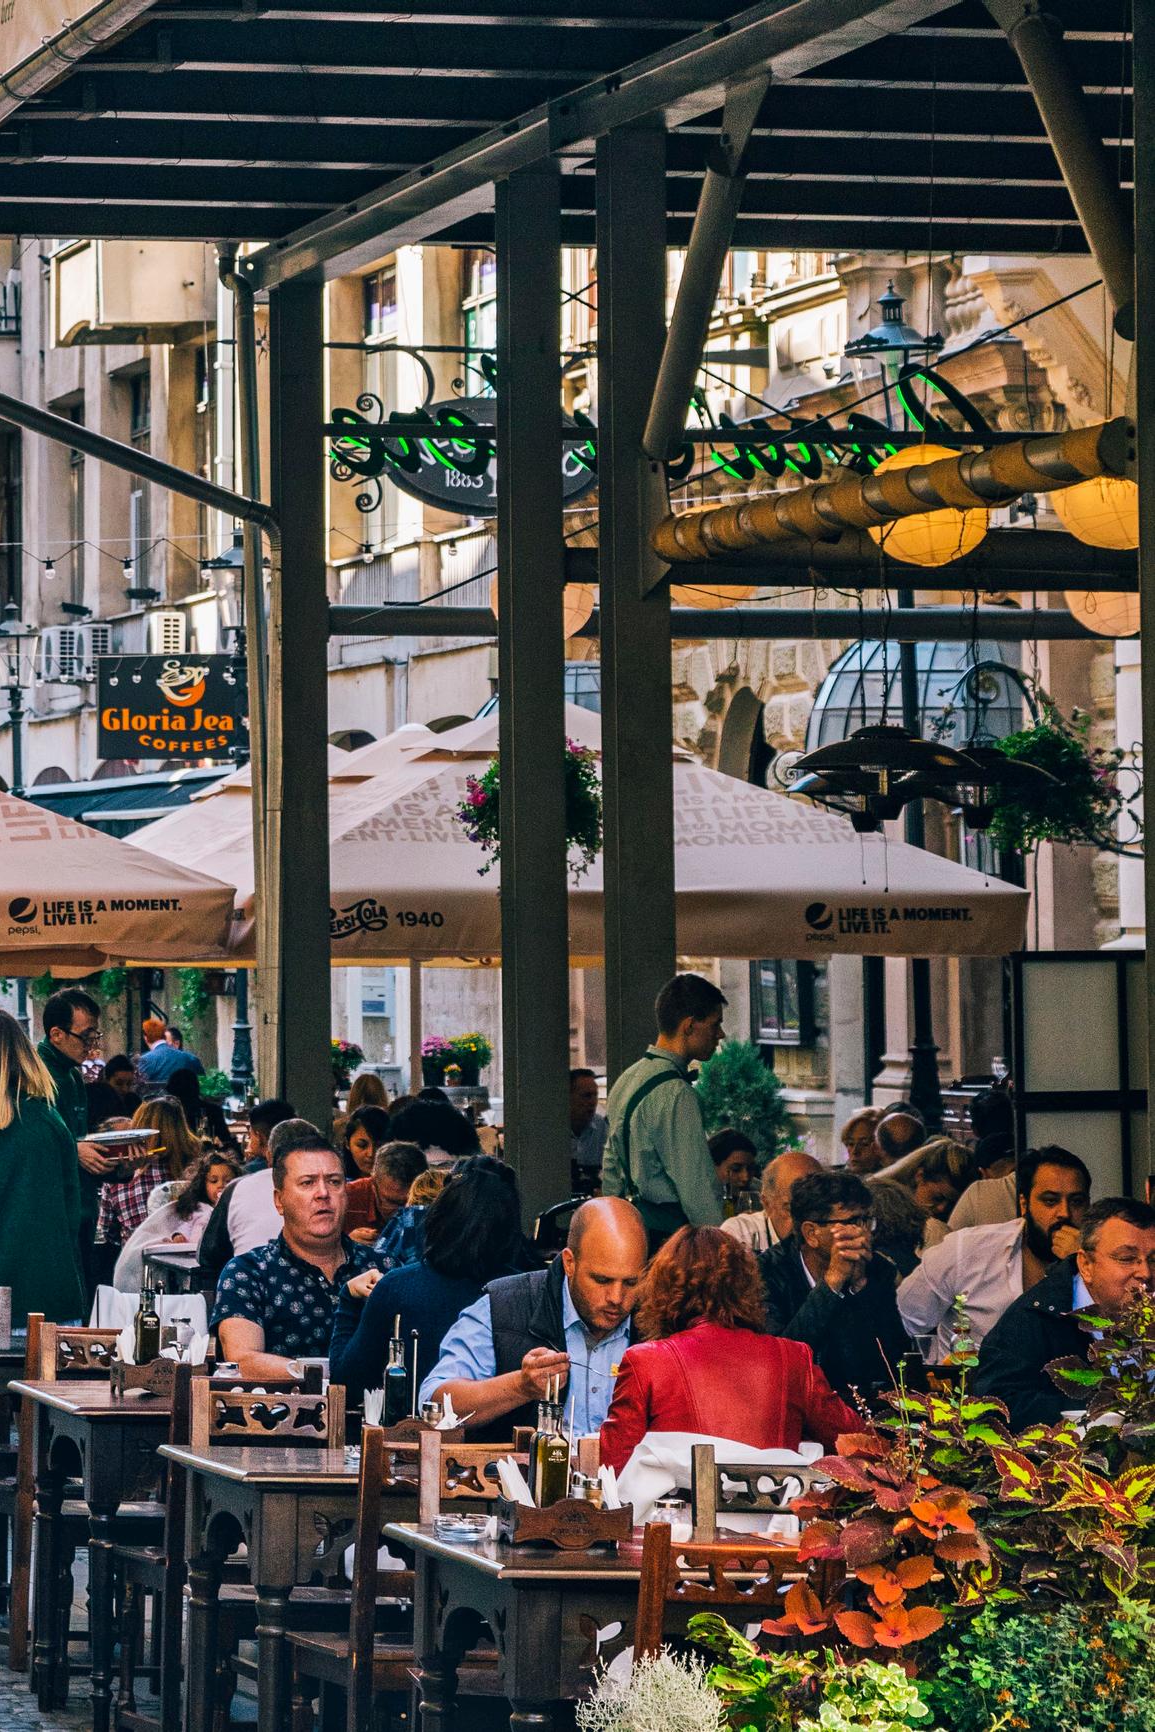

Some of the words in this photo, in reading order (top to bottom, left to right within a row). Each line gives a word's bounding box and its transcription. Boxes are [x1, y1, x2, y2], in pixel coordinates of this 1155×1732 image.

[445, 468, 485, 489] 1883
[101, 707, 186, 731] Gloria
[190, 708, 234, 731] Jea
[138, 734, 228, 752] COFFEES
[44, 901, 74, 914] LIFE
[78, 901, 92, 912] IS
[96, 901, 107, 911] A
[111, 899, 182, 911] MOMENT.
[44, 914, 76, 926] LIVE
[80, 912, 97, 924] IT.
[396, 912, 444, 927] 1940
[839, 908, 868, 920] LIFE
[872, 908, 886, 920] IS
[890, 908, 900, 920] A
[904, 908, 973, 921] MOMENT.
[839, 921, 870, 933] LIVE
[874, 921, 890, 933] IT.
